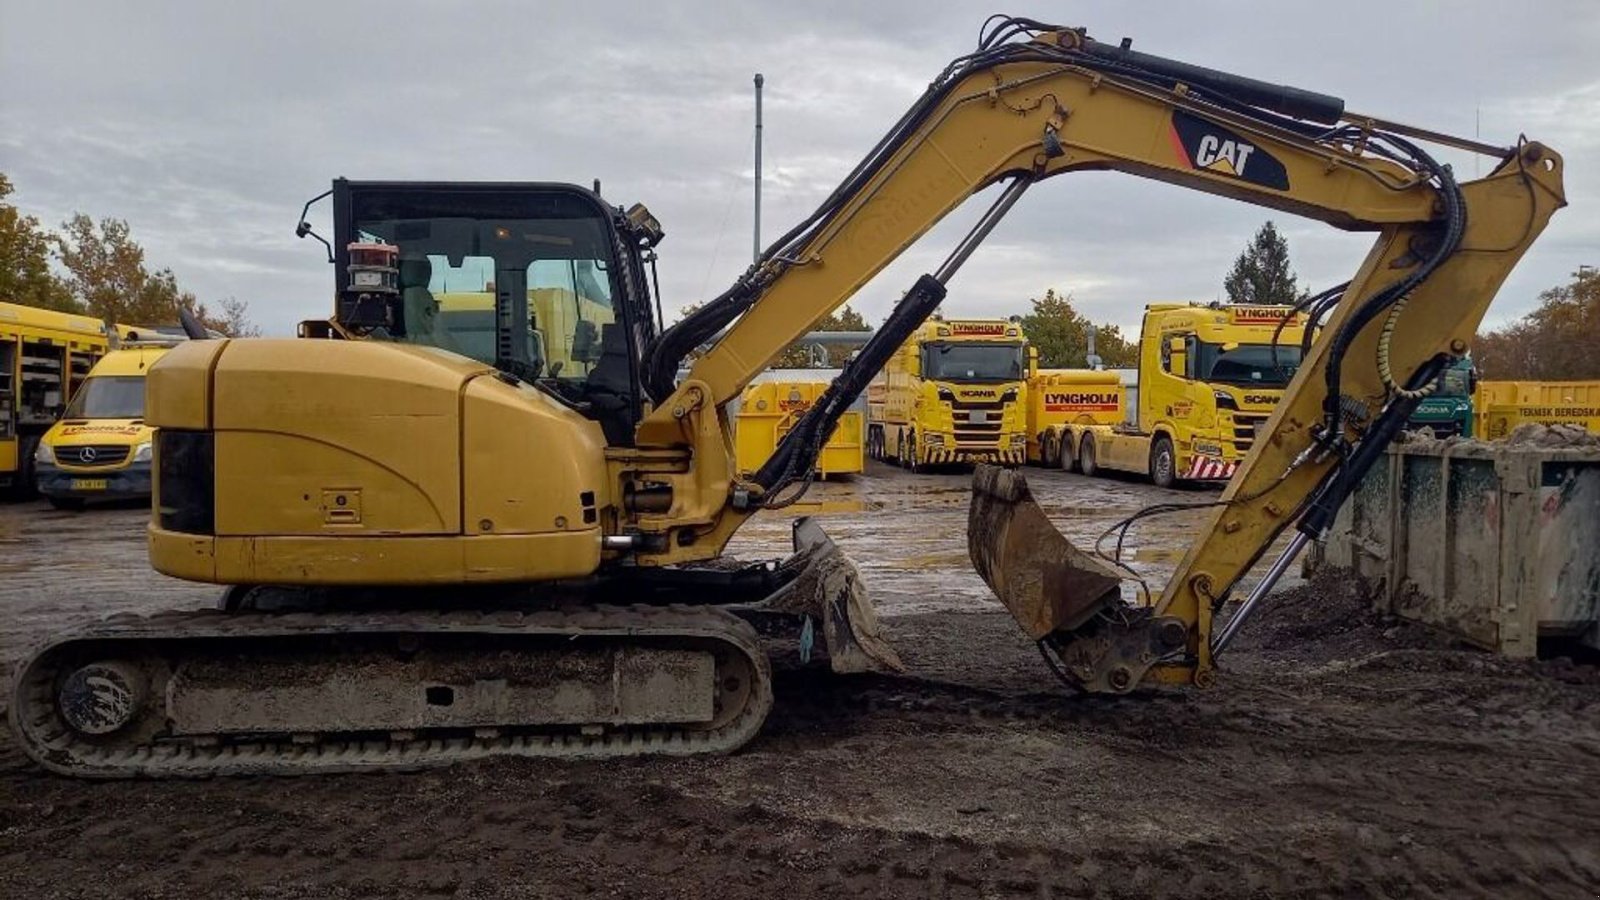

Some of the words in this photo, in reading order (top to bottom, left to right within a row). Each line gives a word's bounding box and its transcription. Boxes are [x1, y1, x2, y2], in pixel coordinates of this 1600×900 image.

[1196, 134, 1254, 176] CAT
[953, 323, 1004, 332] LYNGHOLM
[1045, 394, 1118, 404] LYNGHOLM
[1243, 395, 1280, 404] SCAN
